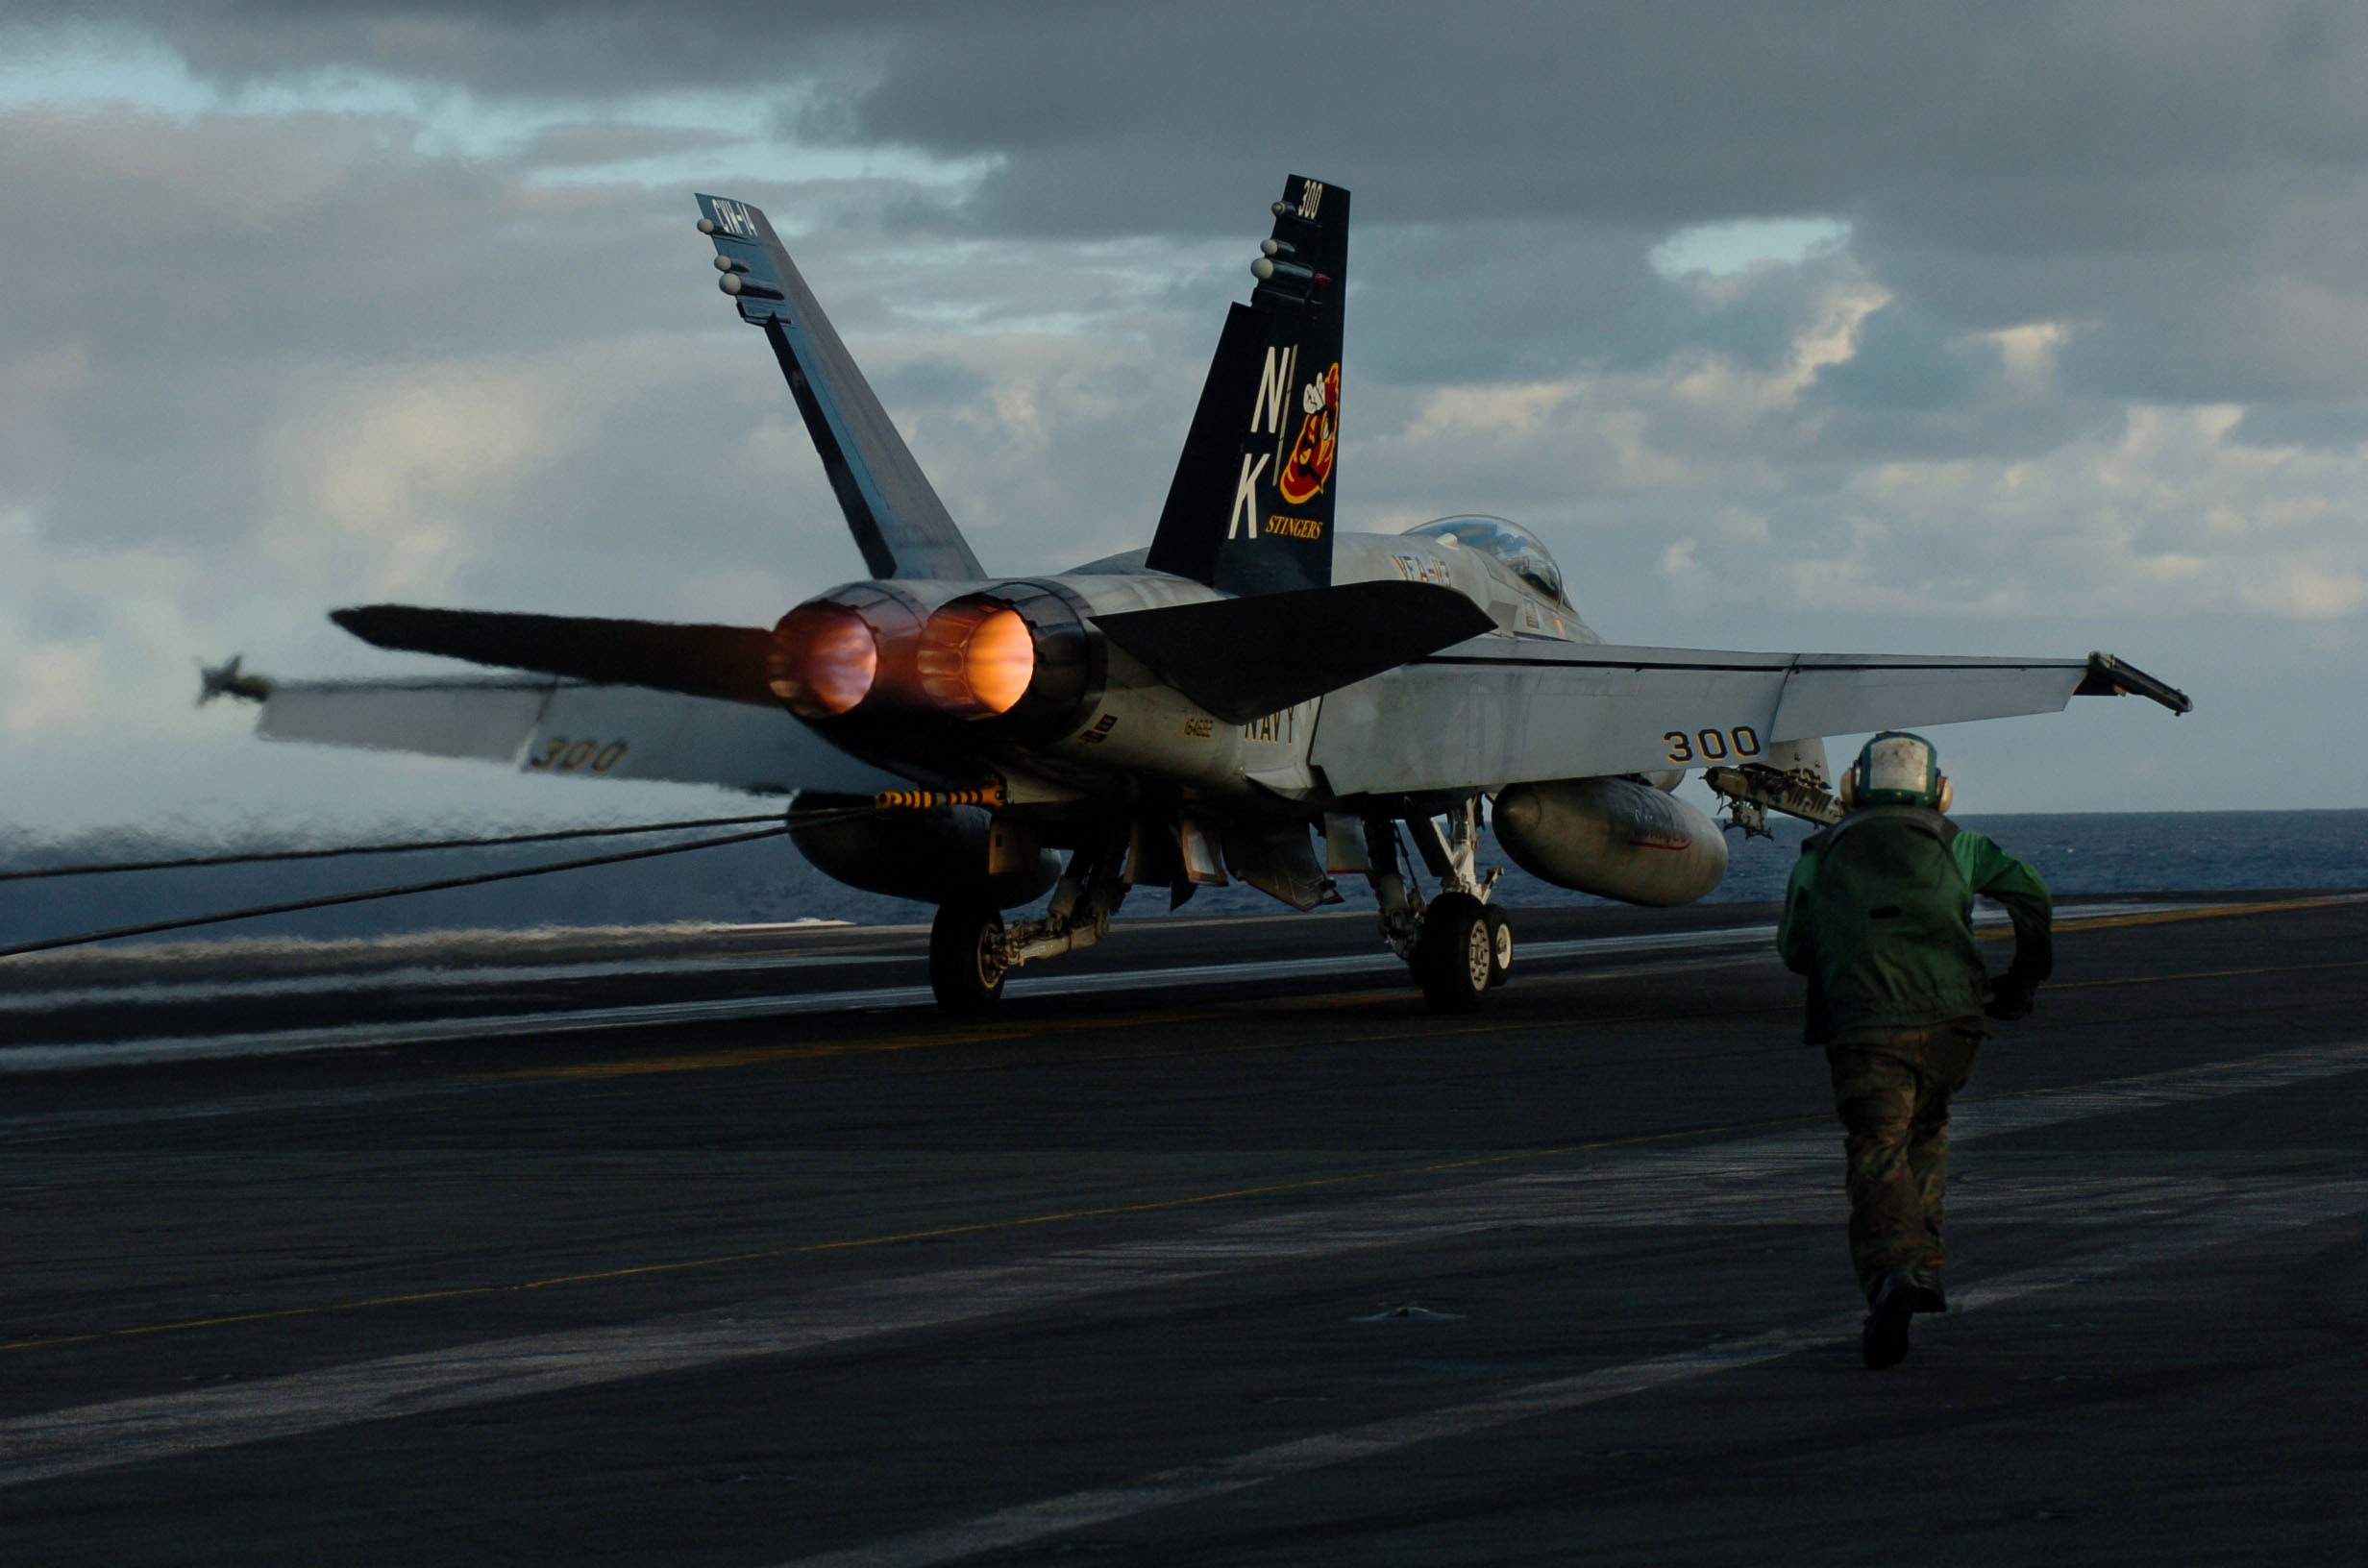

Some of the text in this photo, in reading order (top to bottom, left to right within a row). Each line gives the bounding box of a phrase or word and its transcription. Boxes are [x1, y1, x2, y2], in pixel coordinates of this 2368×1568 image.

[711, 198, 758, 237] CVW-14
[1297, 179, 1323, 222] 300
[1250, 345, 1291, 435] N
[1227, 453, 1270, 540] K
[1265, 514, 1323, 540] STINGERS
[531, 737, 629, 772] 300
[1663, 725, 1761, 764] 300
